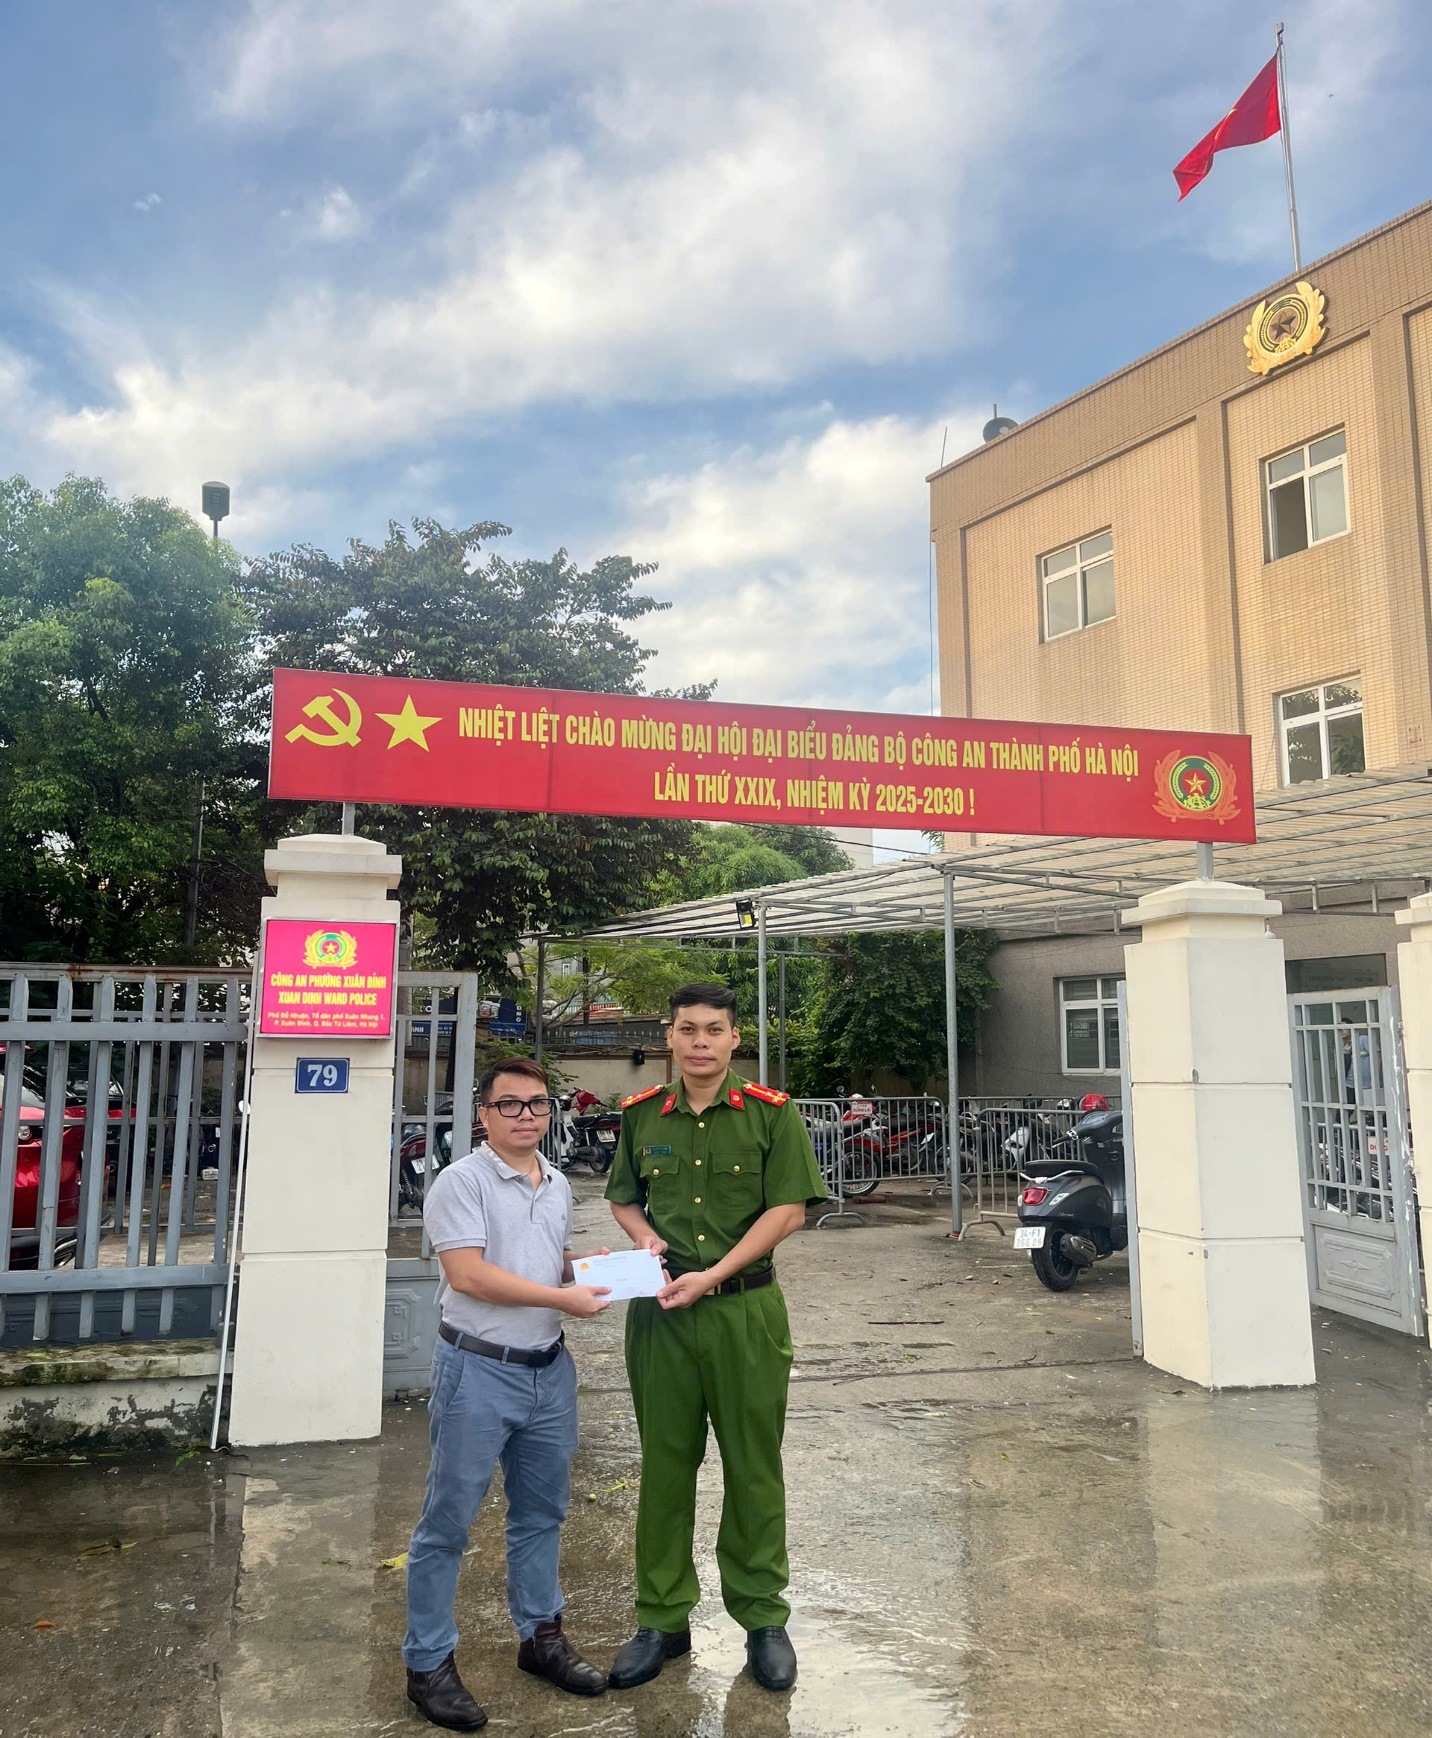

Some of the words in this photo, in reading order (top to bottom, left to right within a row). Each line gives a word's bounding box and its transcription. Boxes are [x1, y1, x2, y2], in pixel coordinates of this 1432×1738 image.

[459, 703, 515, 746] NHIỆT
[521, 706, 559, 750] LIỆT
[565, 711, 615, 748] CHÀO
[621, 714, 676, 751] MỪNG
[681, 721, 712, 759] ĐẠI
[717, 721, 748, 761] HỘI
[752, 727, 782, 764] ĐẠI
[787, 720, 827, 760] BIỂU
[832, 724, 880, 763] ĐẢNG
[883, 730, 907, 771] BỘ
[911, 731, 958, 768] CÔNG
[962, 740, 986, 769] AN
[990, 736, 1044, 771] THÀNH
[1048, 736, 1081, 773] PHỐ
[1085, 741, 1108, 775] HÀ
[1110, 743, 1139, 783] NỘI
[654, 762, 690, 802] LẦN
[694, 770, 732, 804] THỨ
[733, 776, 782, 810] XXIX,
[786, 774, 844, 815] NHIỆM
[848, 775, 871, 811] KỲ
[875, 783, 965, 815] 2025-2030
[969, 788, 975, 815] !
[270, 972, 294, 987] CÔNG
[295, 974, 307, 987] AN
[278, 991, 301, 1004] XUAN
[302, 992, 322, 1005] DINH
[324, 992, 347, 1005] WARD
[349, 993, 377, 1006] POLICE
[307, 1064, 338, 1087] 79
